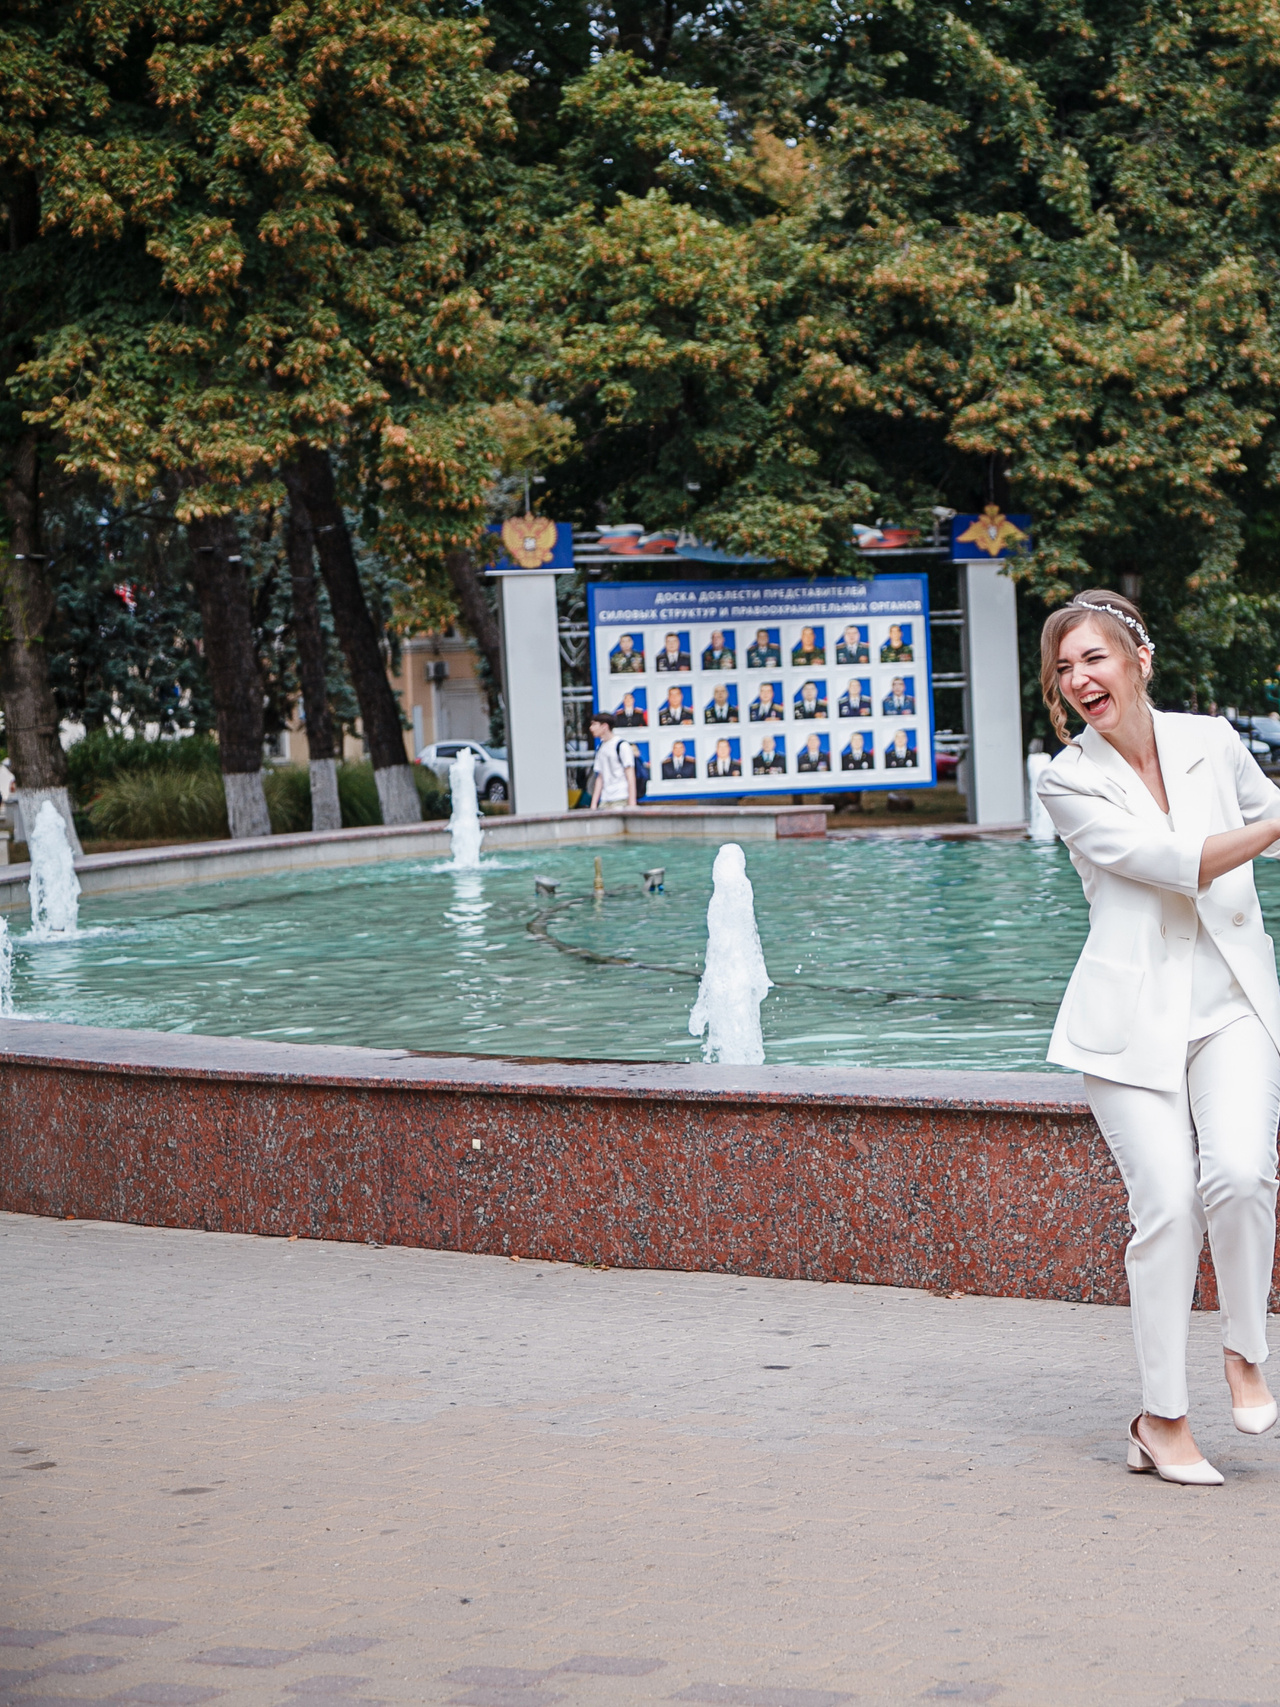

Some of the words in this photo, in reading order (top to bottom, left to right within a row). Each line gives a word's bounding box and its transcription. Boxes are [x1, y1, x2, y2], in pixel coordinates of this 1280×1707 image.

[654, 591, 697, 604] ДОСКА
[698, 589, 761, 603] ДОБЛЕСТИ
[763, 584, 867, 600] ПРЕДСТАВИТЕЛЕЙ
[599, 609, 658, 621] СИЛОВЫХ
[659, 607, 717, 619] СТРУКТУР
[719, 606, 729, 616] И
[731, 602, 868, 616] ПРАВООХРАНИТЕЛЬНЫХ
[869, 600, 921, 613] ОРГАНОВ
